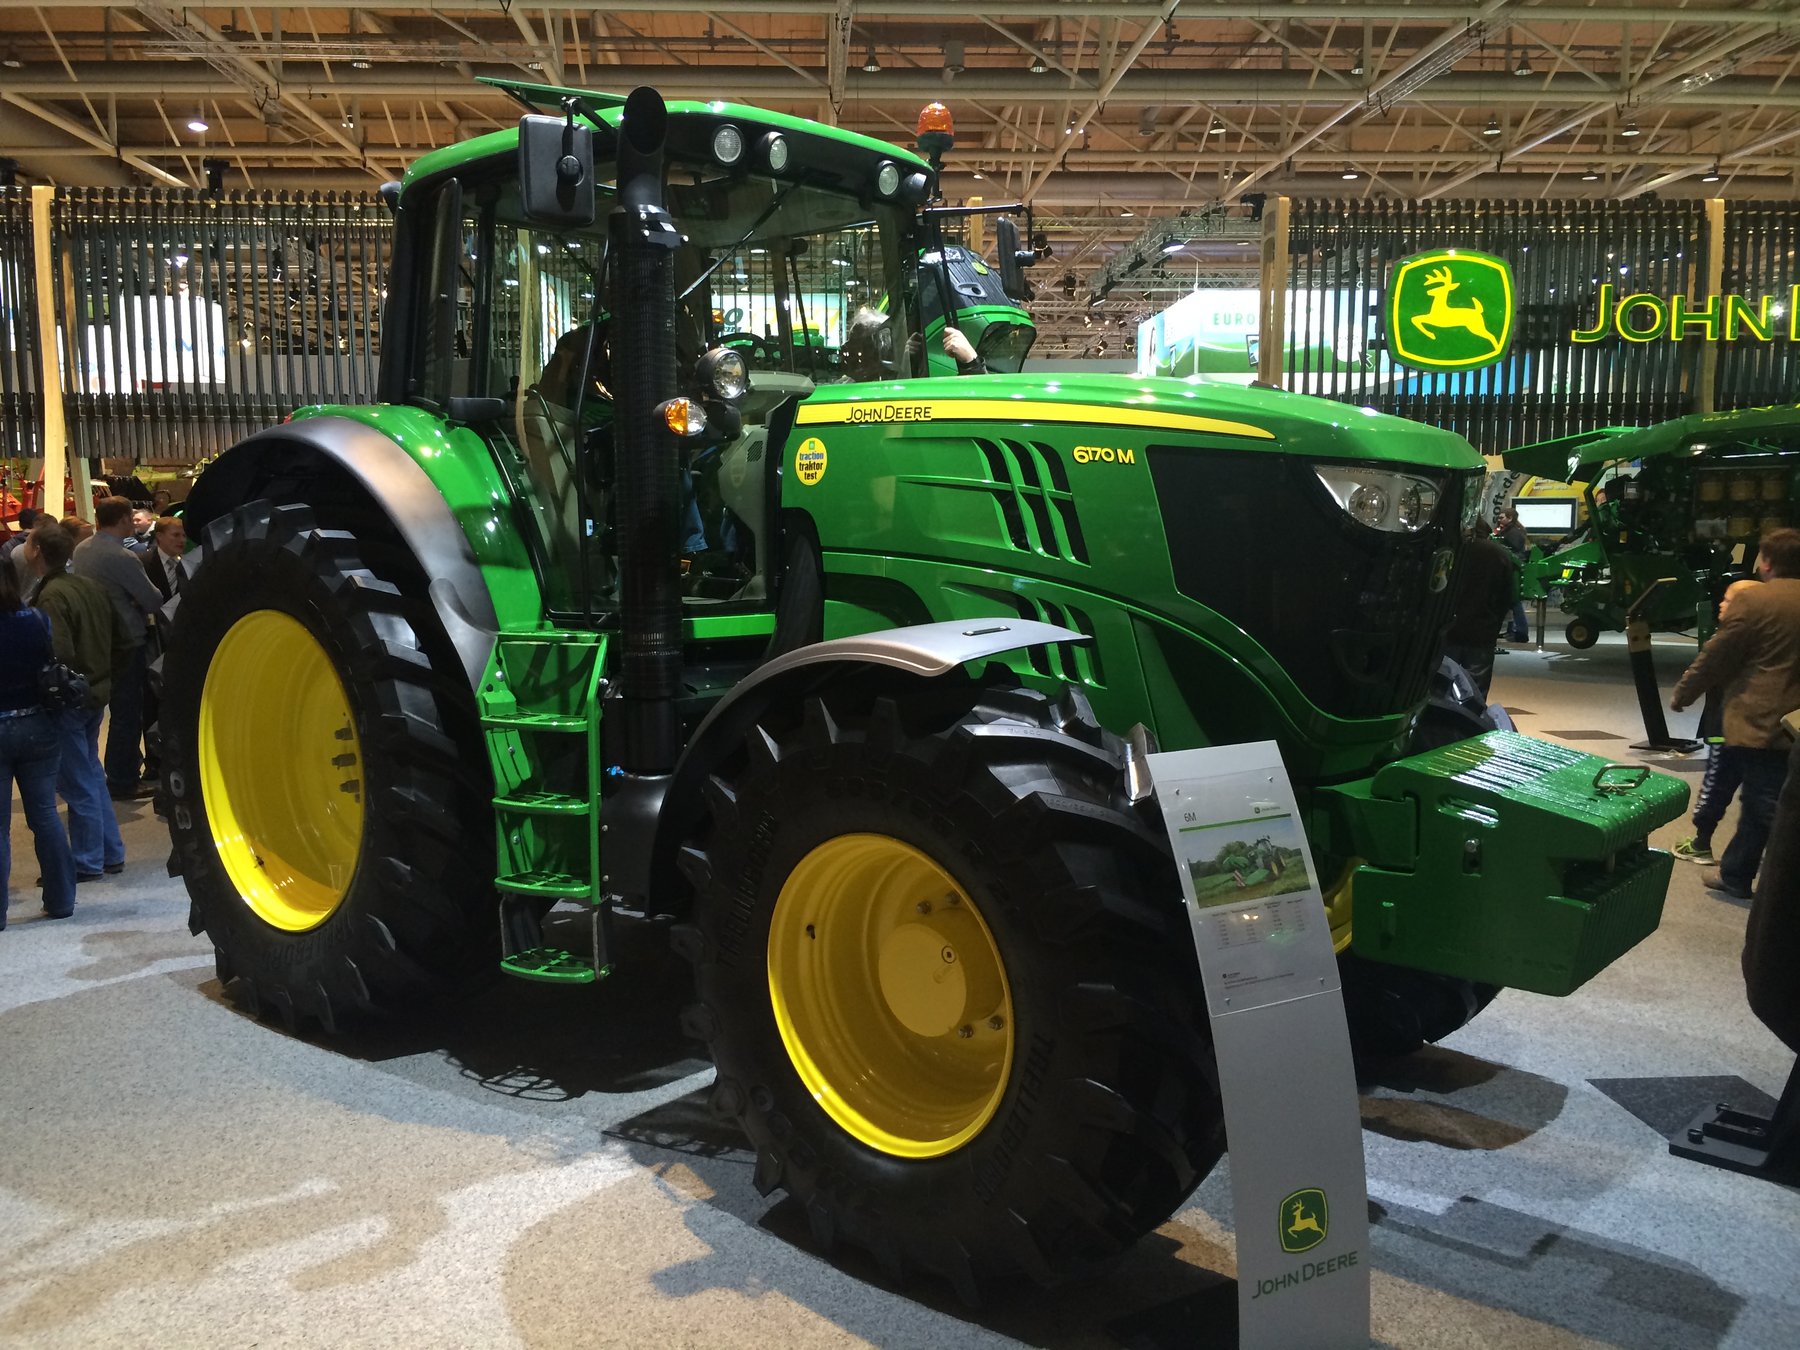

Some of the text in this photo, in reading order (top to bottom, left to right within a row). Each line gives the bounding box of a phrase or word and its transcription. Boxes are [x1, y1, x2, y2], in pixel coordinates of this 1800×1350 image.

[1571, 283, 1774, 343] JOHN
[846, 405, 932, 421] JOHN DEERE
[799, 451, 824, 461] traction
[799, 460, 823, 472] traktor
[804, 471, 818, 481] test
[1183, 811, 1198, 824] 6M
[1252, 1251, 1358, 1300] JOHN DEERE
